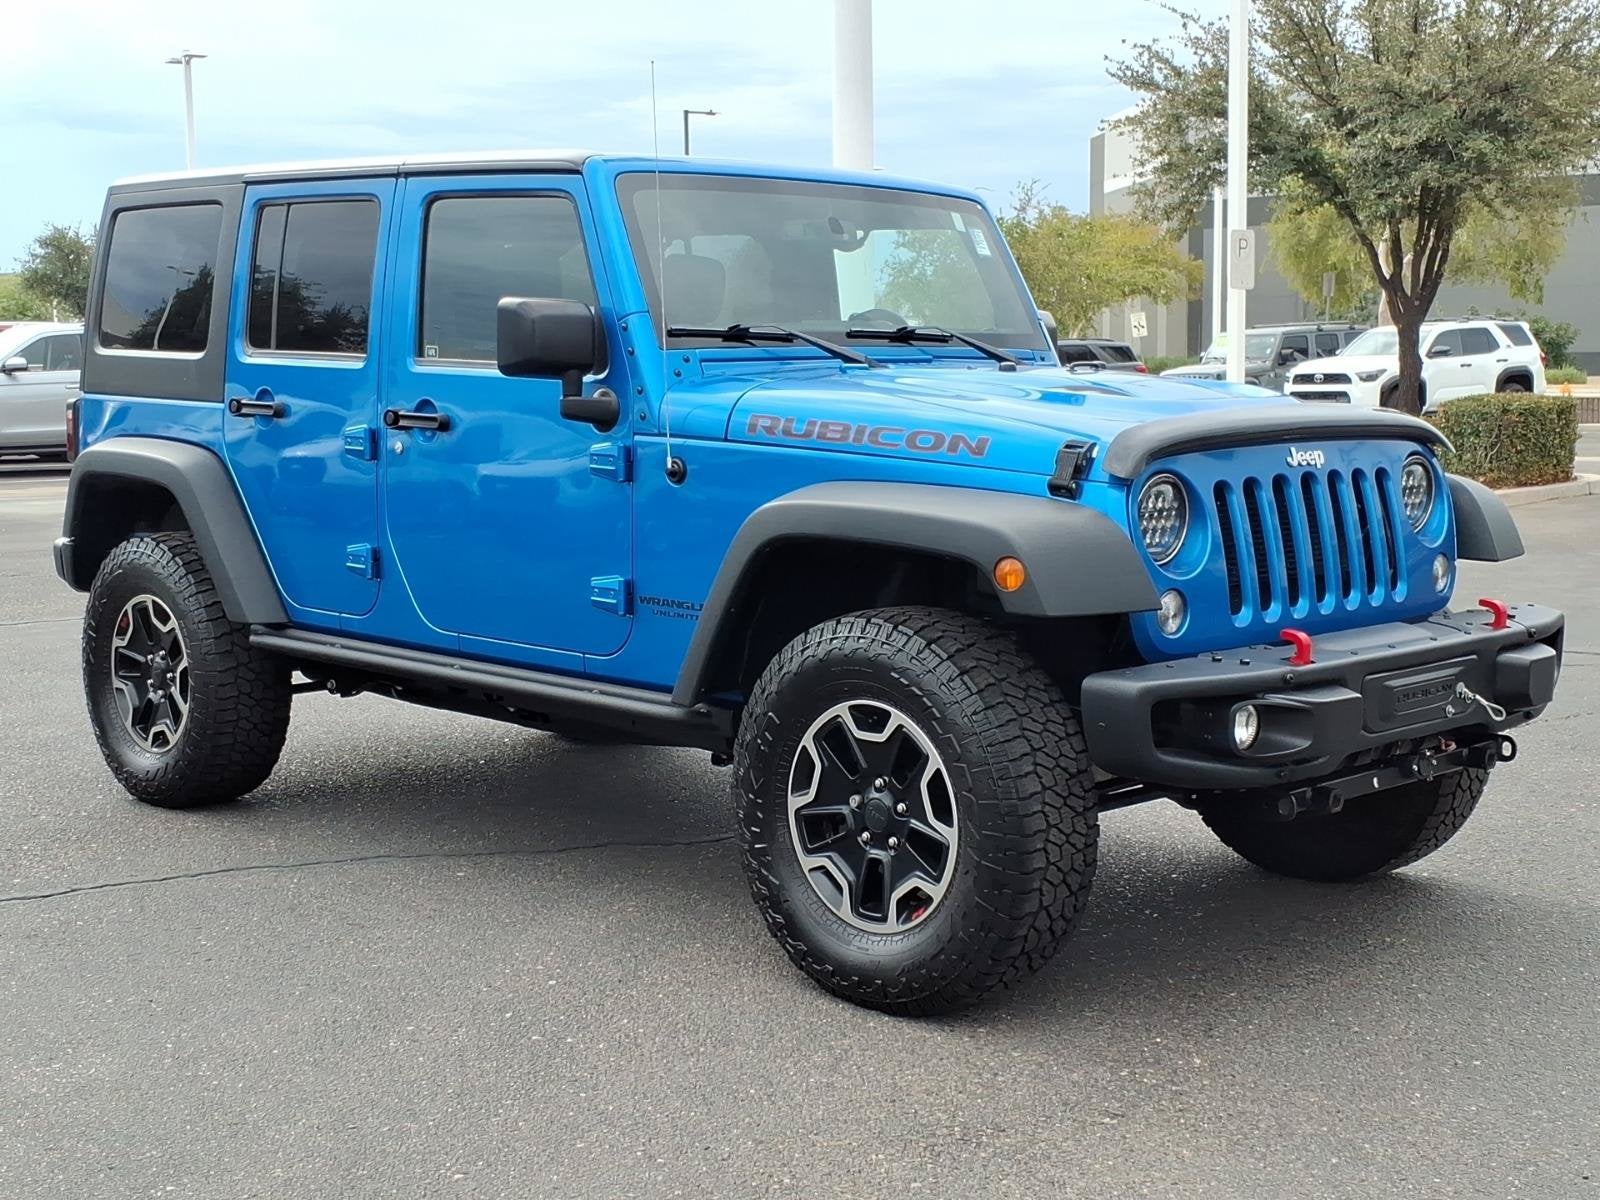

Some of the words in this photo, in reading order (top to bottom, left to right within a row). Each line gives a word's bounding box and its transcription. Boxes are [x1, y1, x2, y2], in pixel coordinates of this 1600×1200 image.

[1238, 238, 1249, 258] P
[746, 413, 992, 458] RUBICON
[1286, 446, 1325, 469] Jeep
